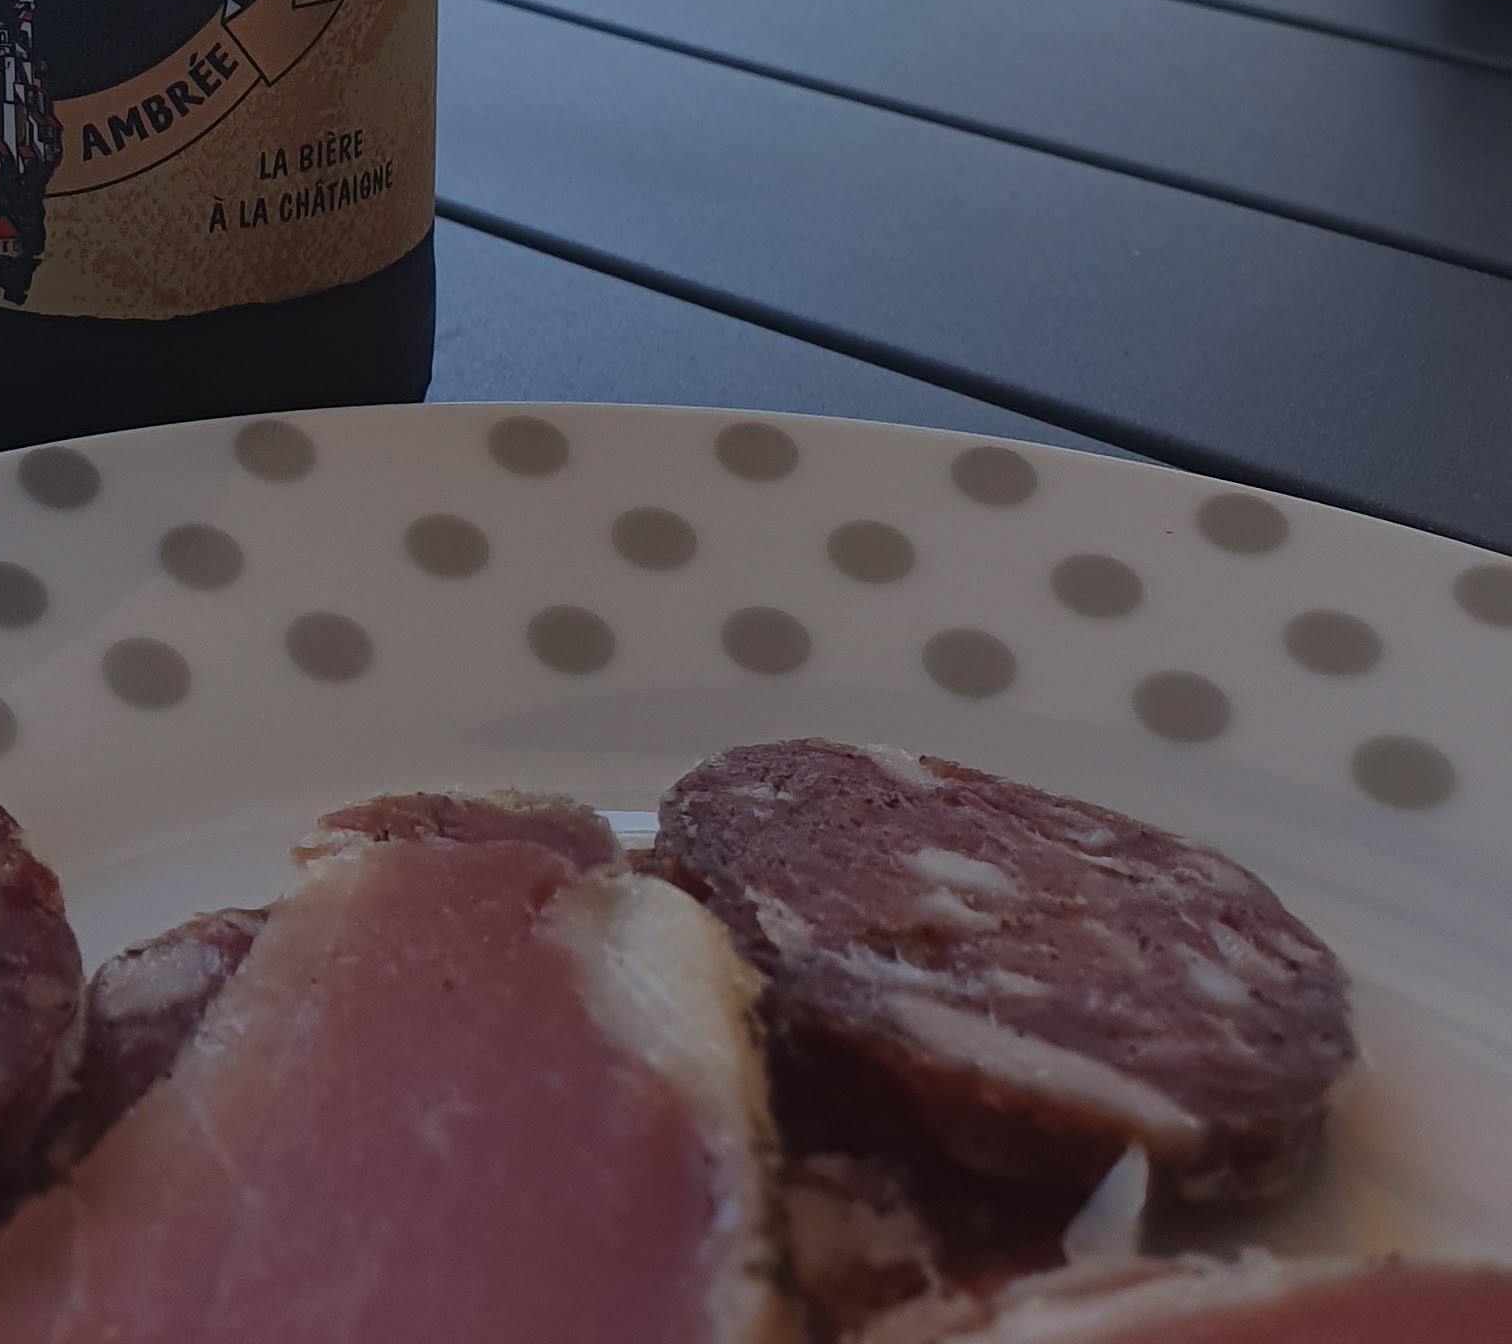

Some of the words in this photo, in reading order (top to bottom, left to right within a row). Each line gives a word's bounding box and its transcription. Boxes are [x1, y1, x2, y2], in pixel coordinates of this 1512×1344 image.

[80, 40, 240, 162] AMBRÉE
[259, 148, 288, 180] LA
[299, 128, 364, 173] BIÈRE
[208, 194, 228, 234] À
[239, 197, 269, 229] LA
[278, 159, 394, 223] CHÂTAIGNE
